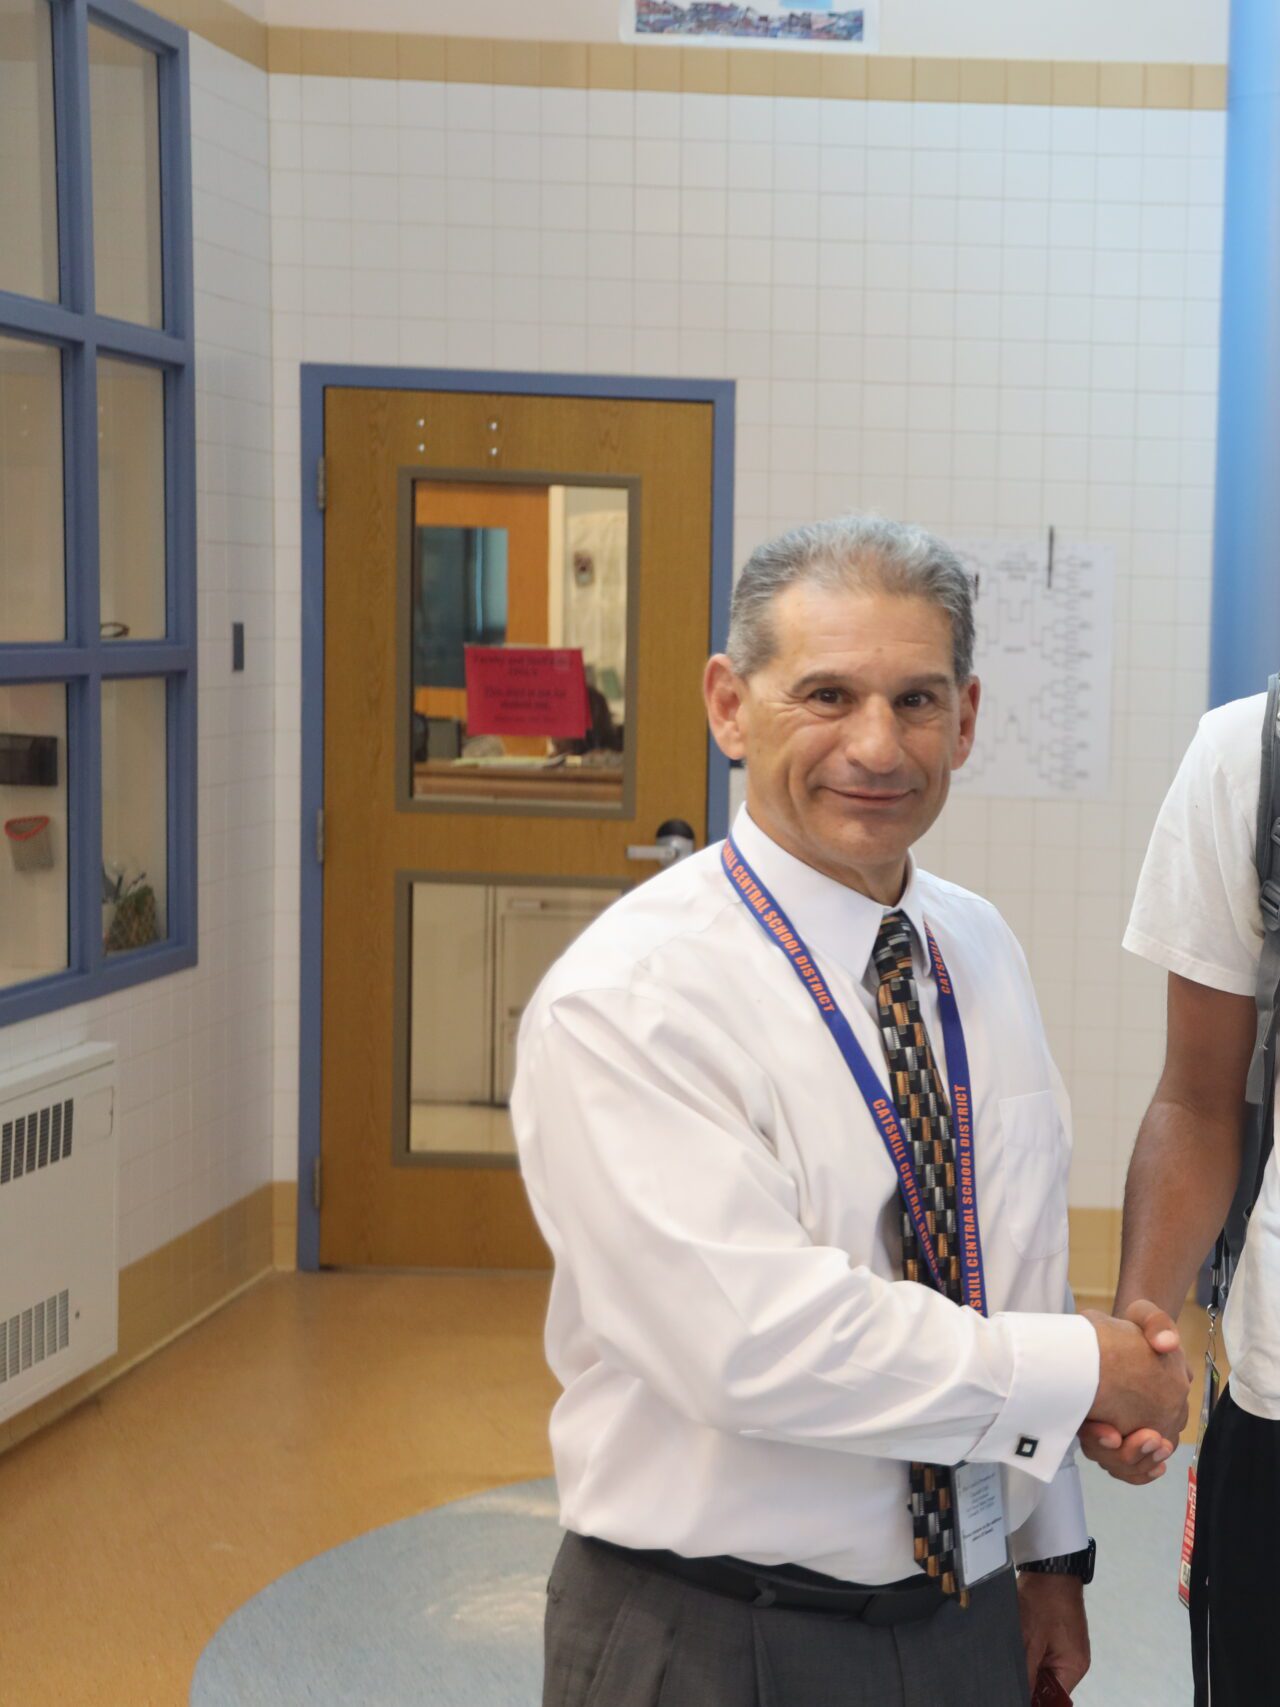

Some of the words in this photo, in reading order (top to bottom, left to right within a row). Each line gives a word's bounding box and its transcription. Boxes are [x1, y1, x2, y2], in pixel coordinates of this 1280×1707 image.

[732, 864, 772, 914] CENTRAL
[763, 910, 803, 956] SCHOOL
[794, 954, 836, 1012] DISTRICT
[953, 1083, 971, 1147] DISTRICT
[872, 1097, 907, 1162] CATSKILL
[899, 1161, 923, 1221] CENTRAL
[960, 1150, 974, 1205] SCHOOL
[963, 1207, 979, 1268] CENTRAL
